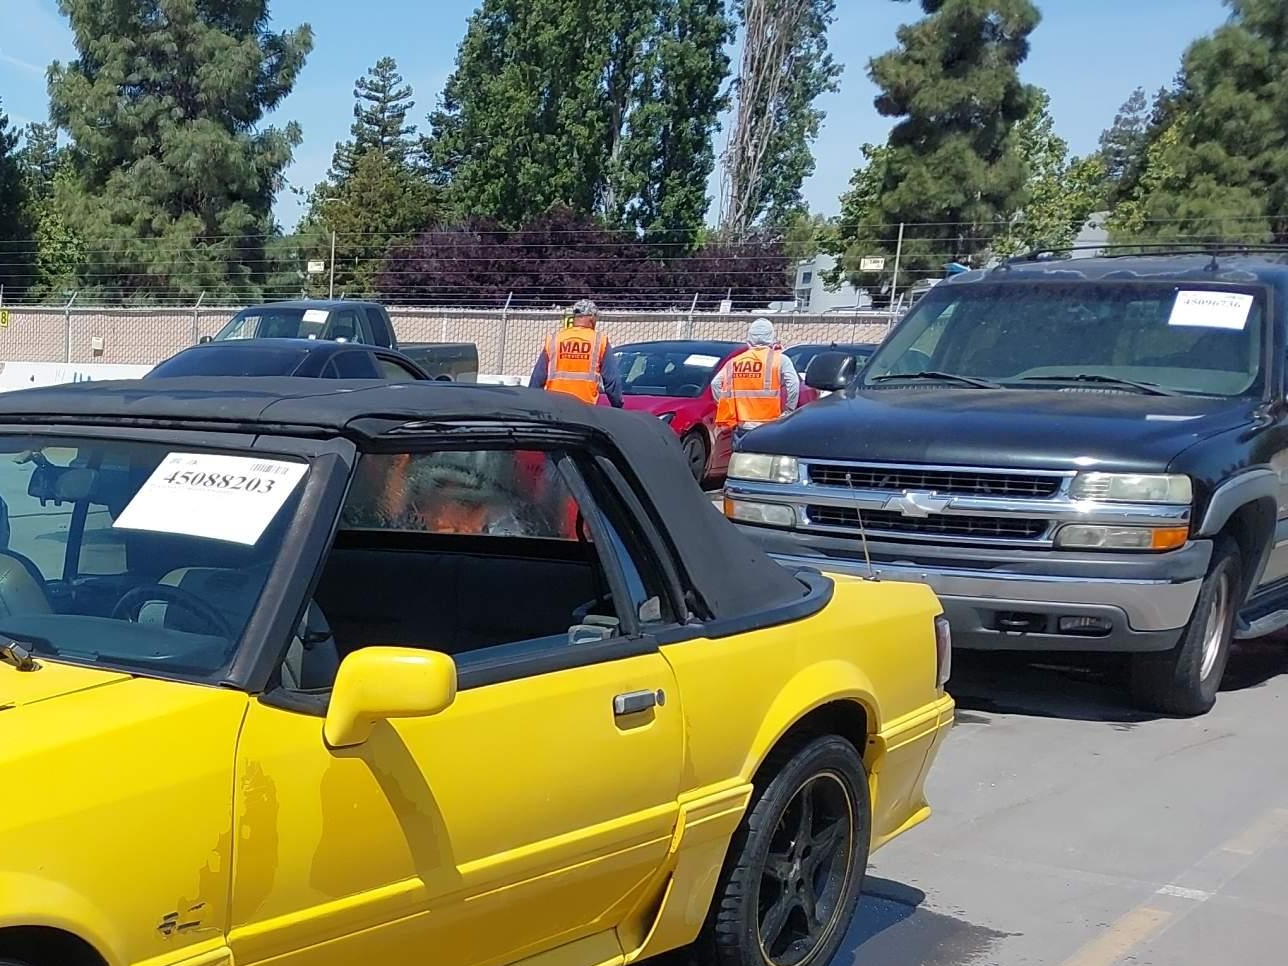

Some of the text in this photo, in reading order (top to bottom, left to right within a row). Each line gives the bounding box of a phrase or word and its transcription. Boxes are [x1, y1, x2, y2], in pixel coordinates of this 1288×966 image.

[0, 311, 8, 325] 8
[559, 341, 591, 354] MAD
[732, 361, 762, 373] MAD
[163, 470, 276, 494] 45088203
